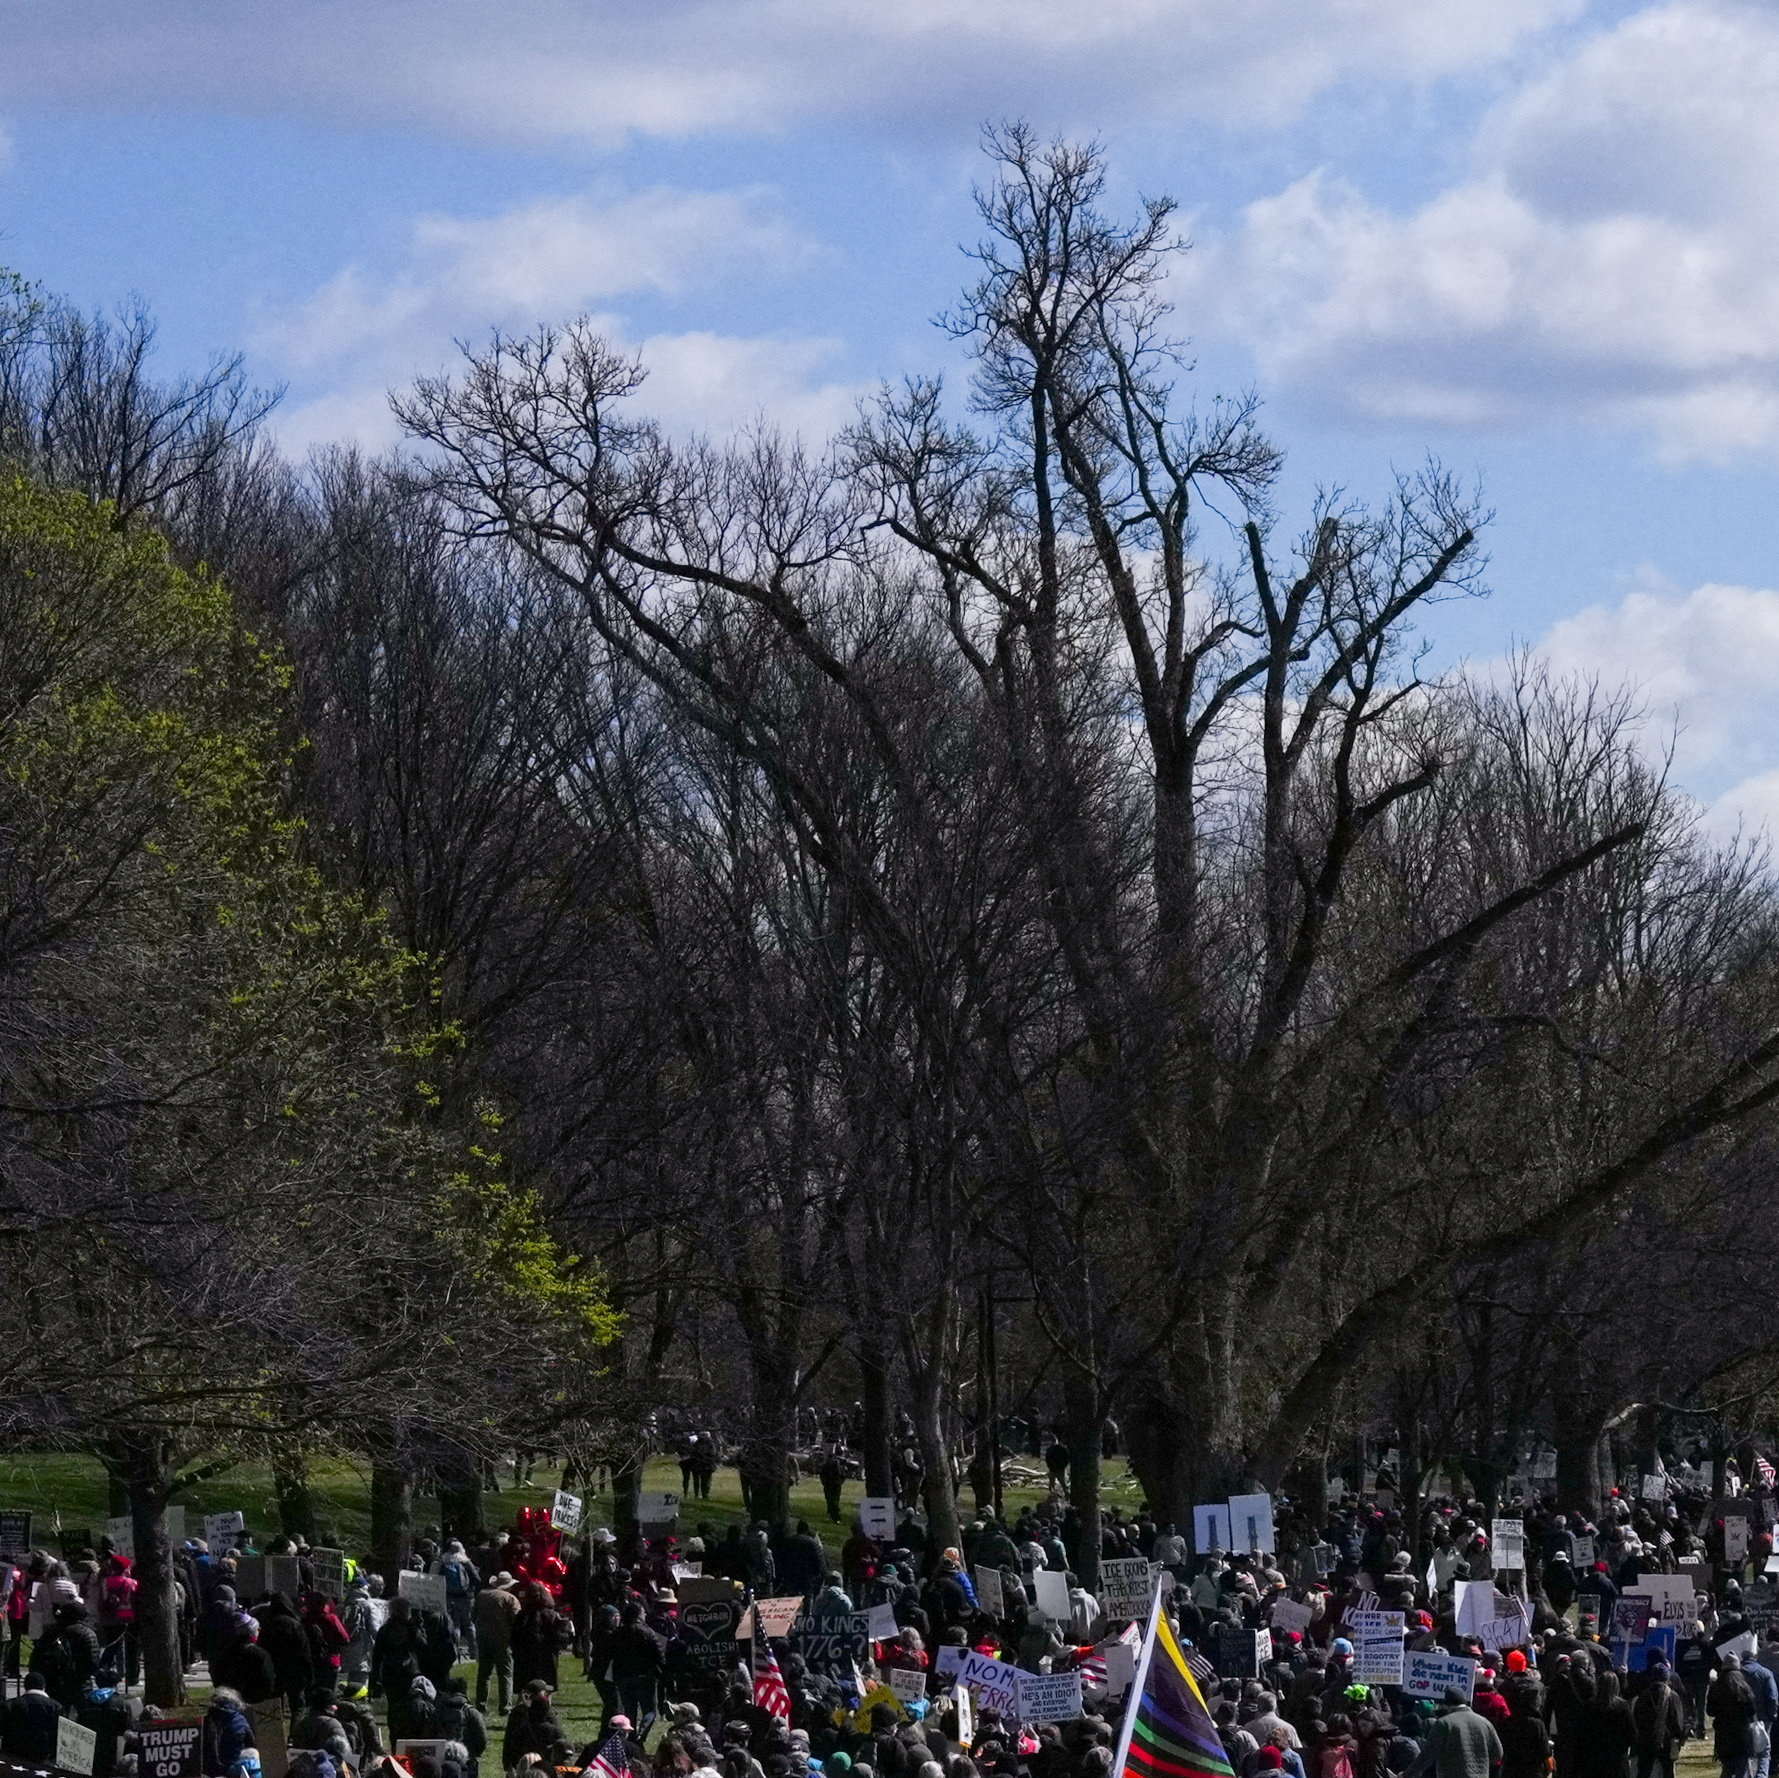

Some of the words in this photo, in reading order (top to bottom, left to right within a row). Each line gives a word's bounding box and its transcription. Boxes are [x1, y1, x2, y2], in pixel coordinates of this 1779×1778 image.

[1103, 1563, 1121, 1578] ICE
[796, 1616, 816, 1633] NO
[820, 1615, 869, 1635] KINGS
[700, 1656, 729, 1669] ICE
[966, 1658, 998, 1680] NO
[1447, 1662, 1469, 1675] Kids
[1411, 1668, 1427, 1679] die
[1408, 1679, 1431, 1690] GOP
[1021, 1692, 1040, 1701] HE'S
[1042, 1690, 1053, 1700] AN
[1055, 1688, 1076, 1698] IDIOT
[140, 1728, 199, 1747] TRUMP
[145, 1744, 193, 1762] MUST
[156, 1761, 181, 1777] GO
